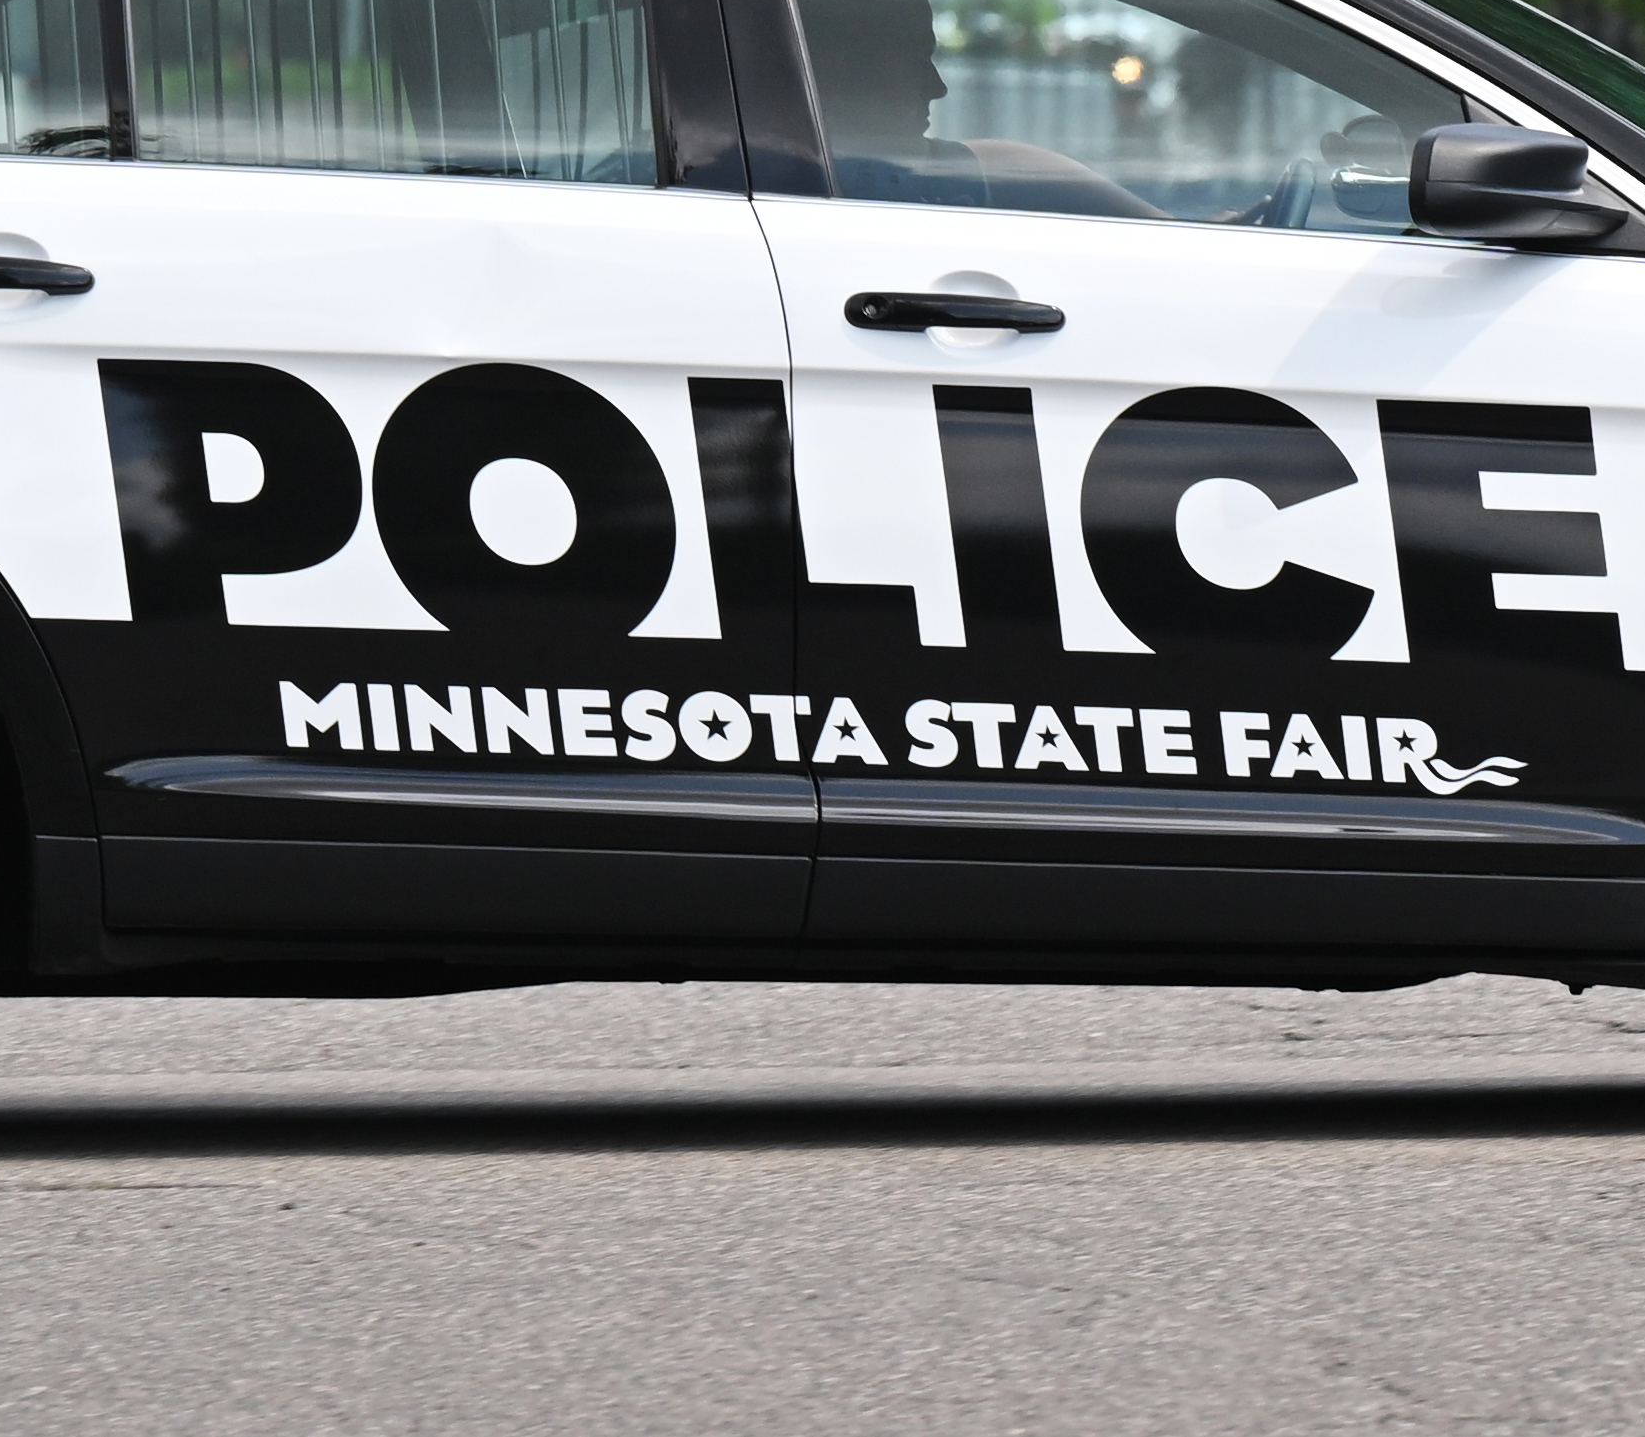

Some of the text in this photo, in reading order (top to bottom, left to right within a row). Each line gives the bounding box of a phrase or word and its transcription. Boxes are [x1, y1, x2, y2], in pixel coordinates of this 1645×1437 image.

[97, 357, 1624, 672] POLICE
[278, 680, 1528, 796] MINNESOTA STATE FAIR
